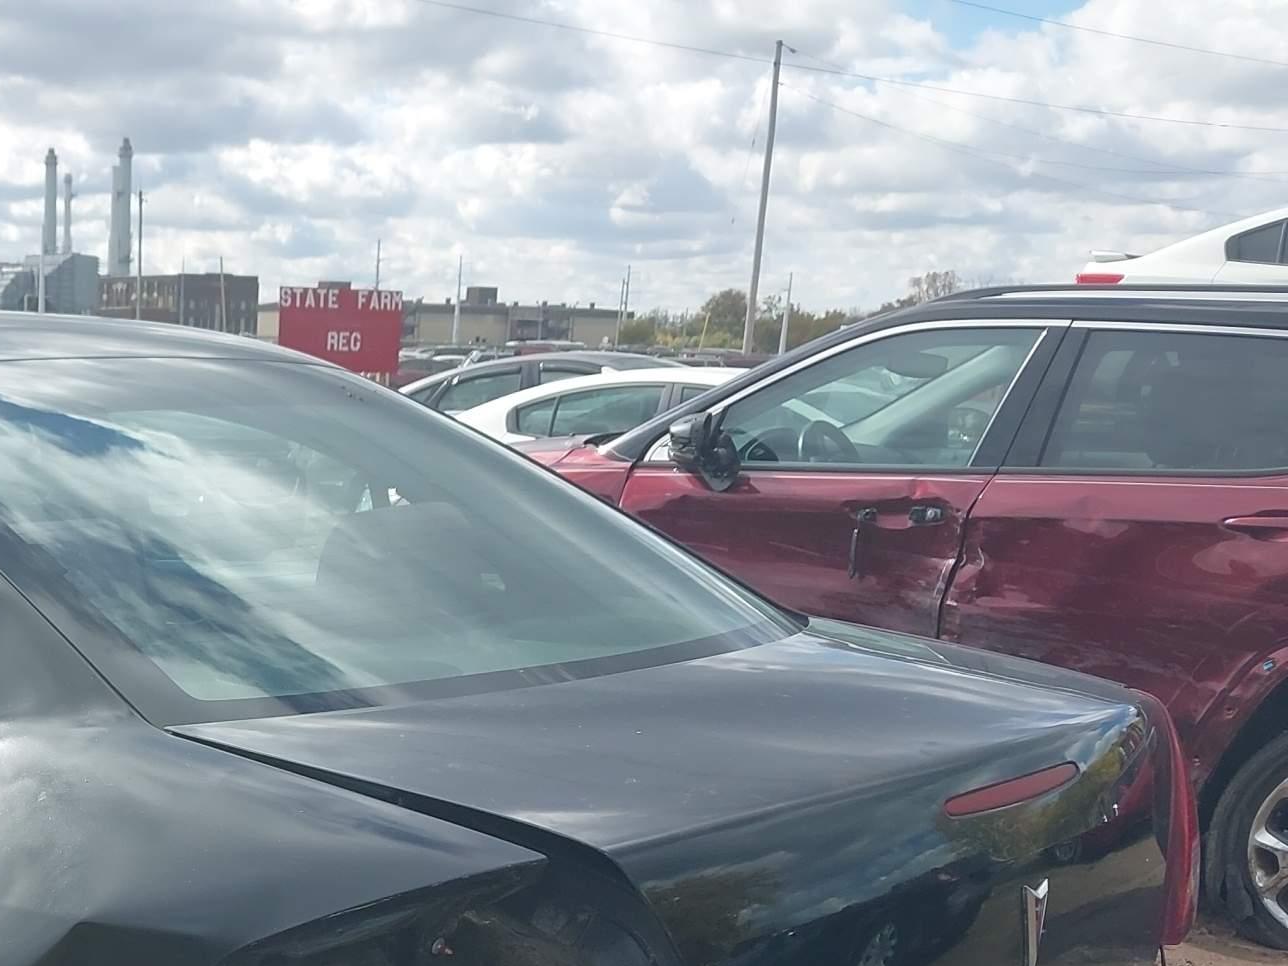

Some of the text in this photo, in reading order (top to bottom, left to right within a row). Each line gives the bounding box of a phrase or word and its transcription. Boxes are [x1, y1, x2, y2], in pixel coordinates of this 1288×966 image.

[280, 287, 403, 312] STATE FARM
[327, 331, 361, 352] REG
